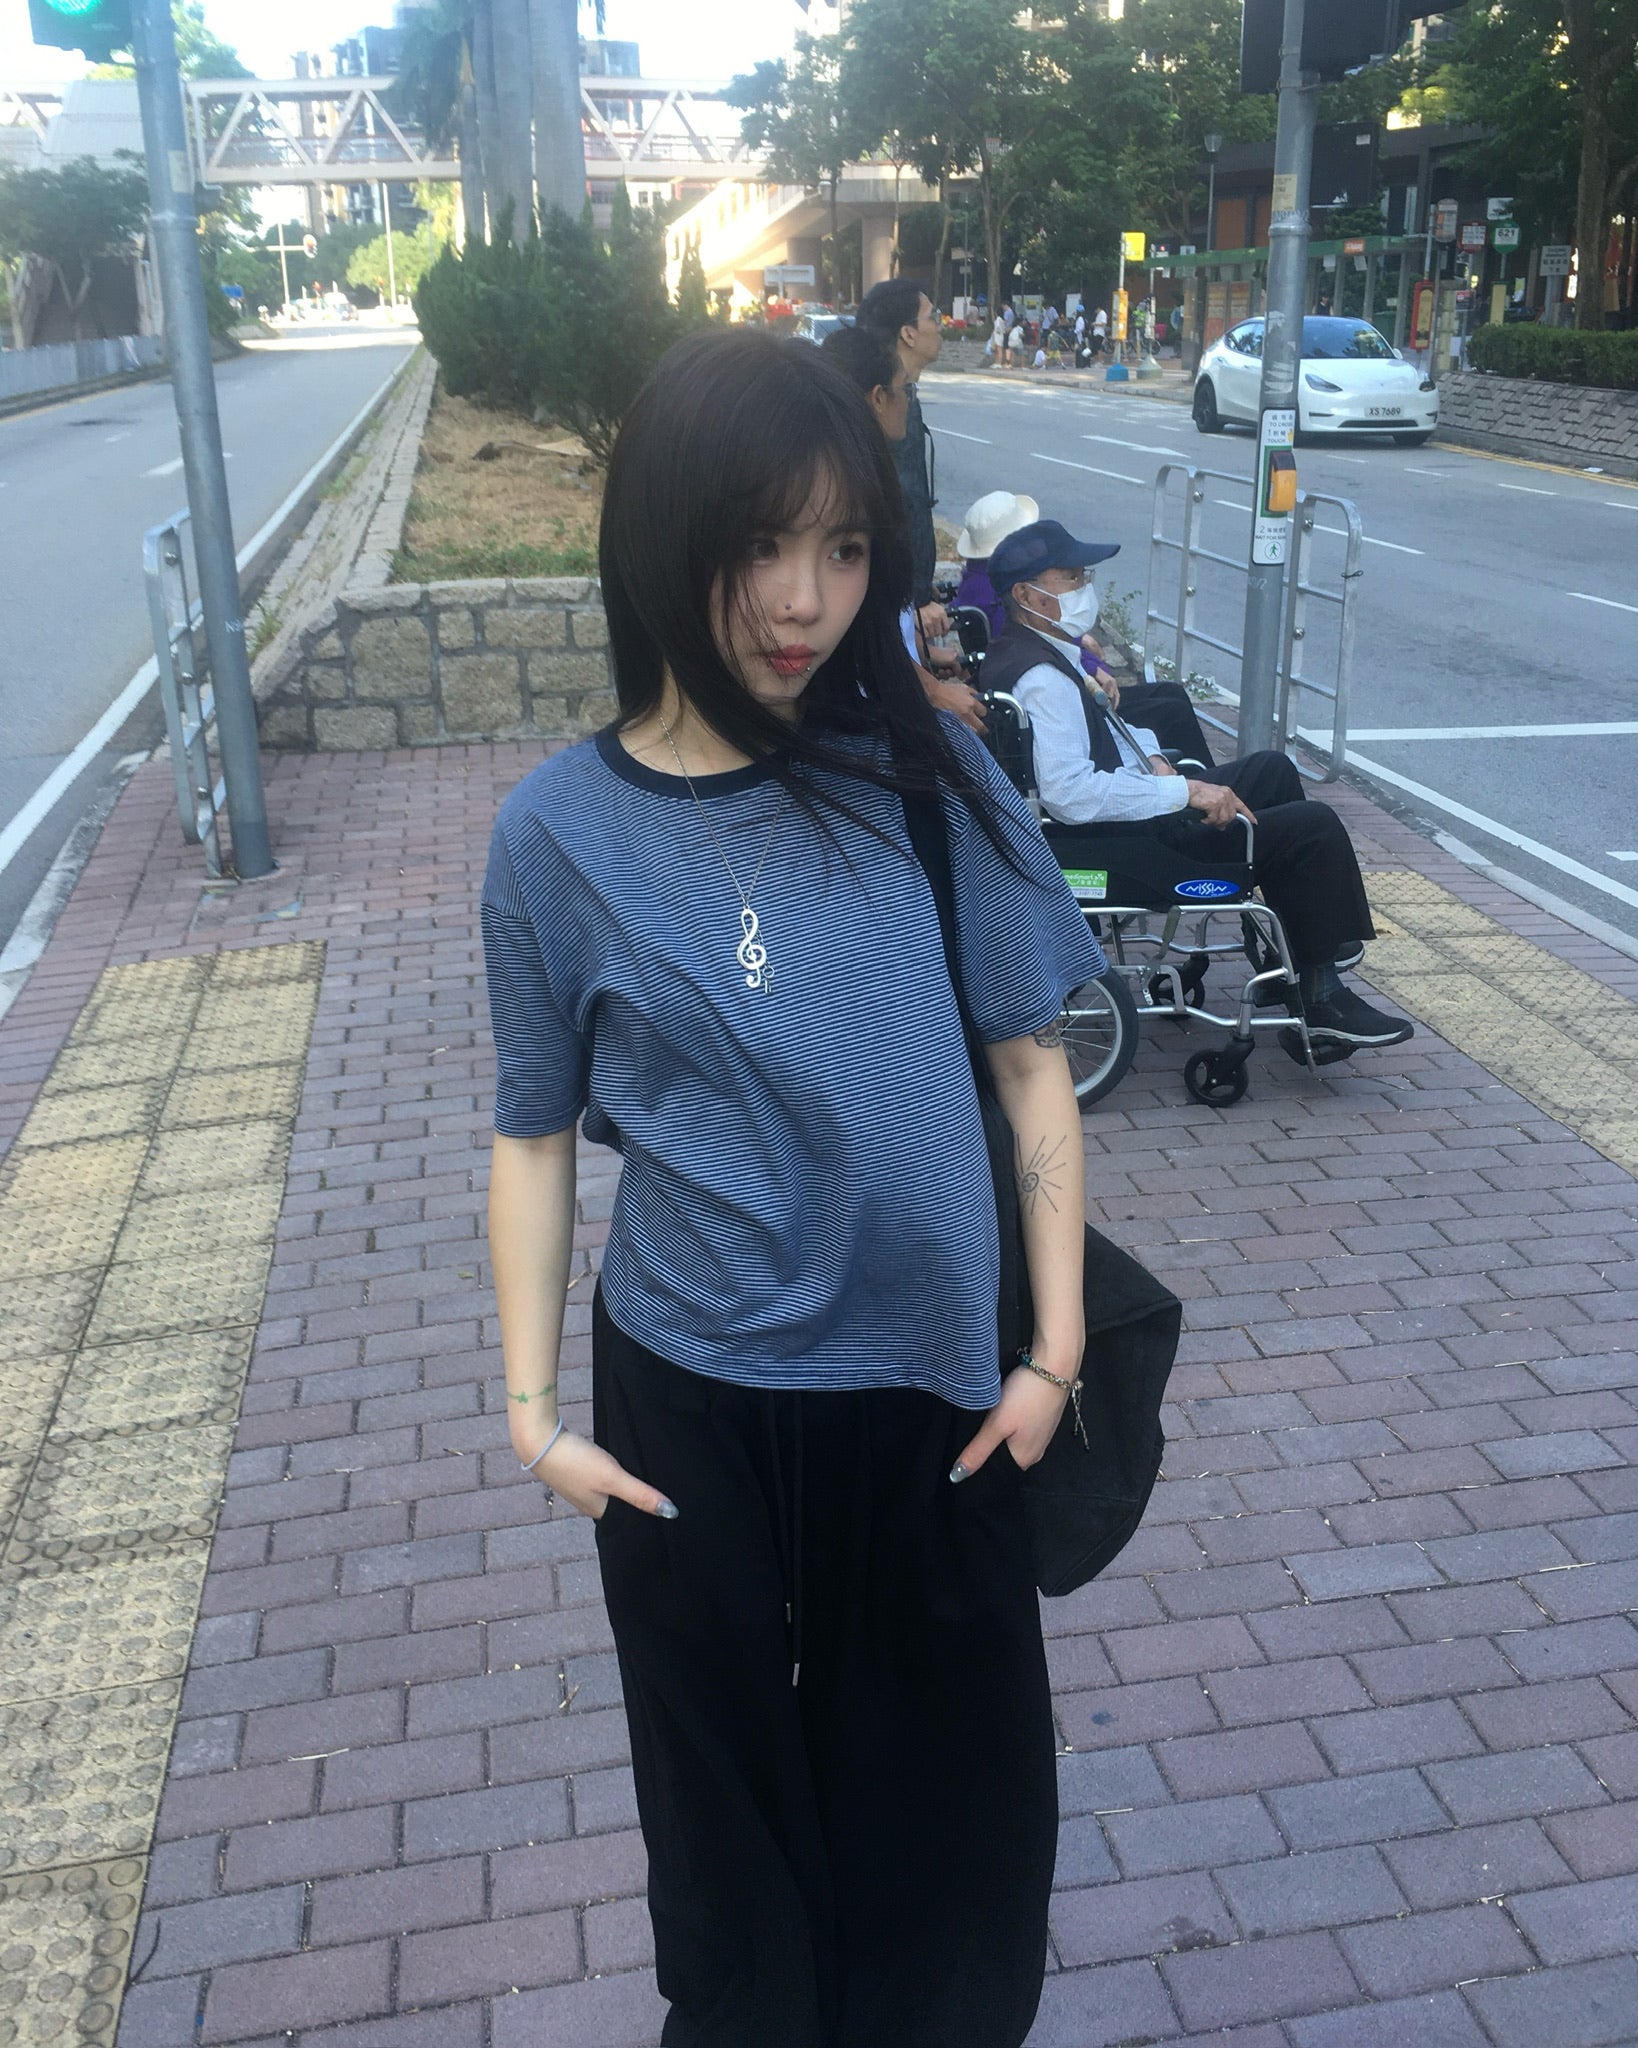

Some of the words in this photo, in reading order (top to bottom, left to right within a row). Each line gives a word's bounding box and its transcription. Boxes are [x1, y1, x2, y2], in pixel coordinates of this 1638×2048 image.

[1498, 228, 1515, 237] 621
[1369, 407, 1380, 416] XS
[1381, 407, 1401, 416] 7689
